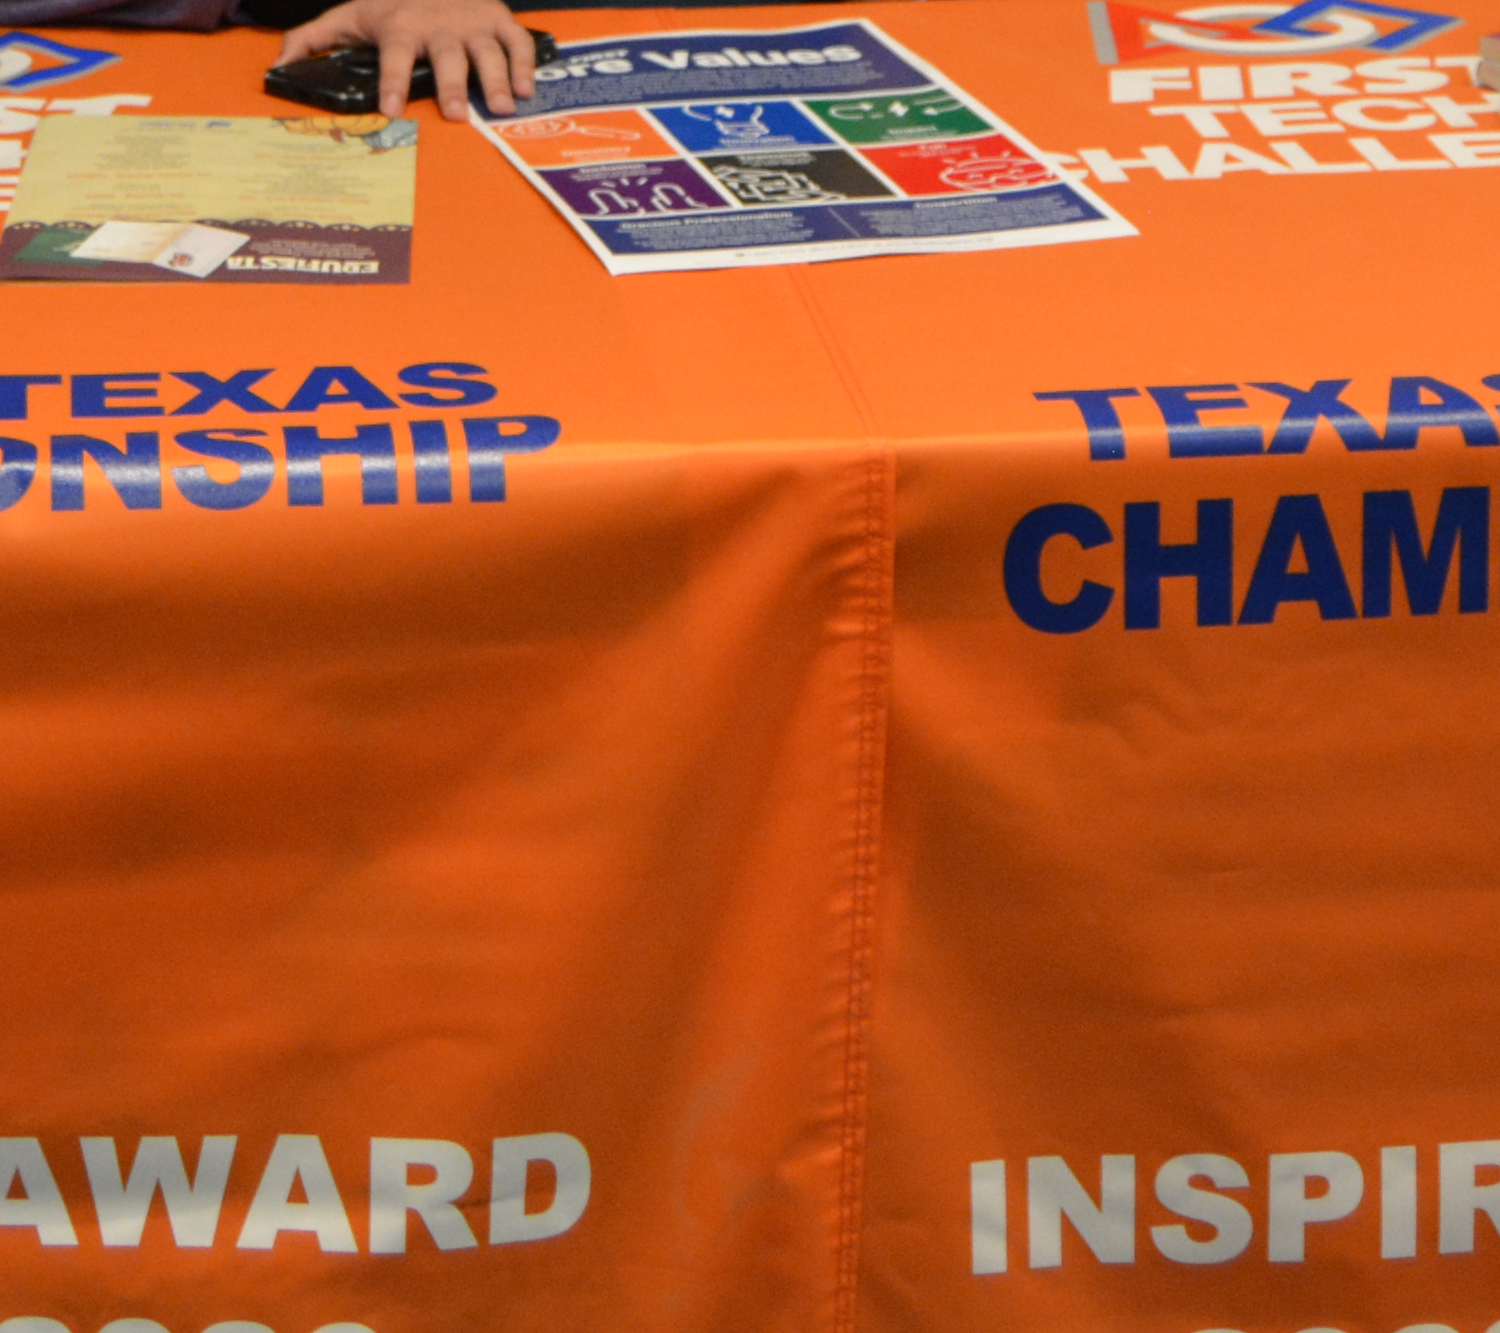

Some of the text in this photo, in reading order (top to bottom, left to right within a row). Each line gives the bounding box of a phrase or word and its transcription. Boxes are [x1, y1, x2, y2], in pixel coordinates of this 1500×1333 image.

[533, 44, 863, 83] ore Values
[227, 255, 380, 275] EDUFIESTA
